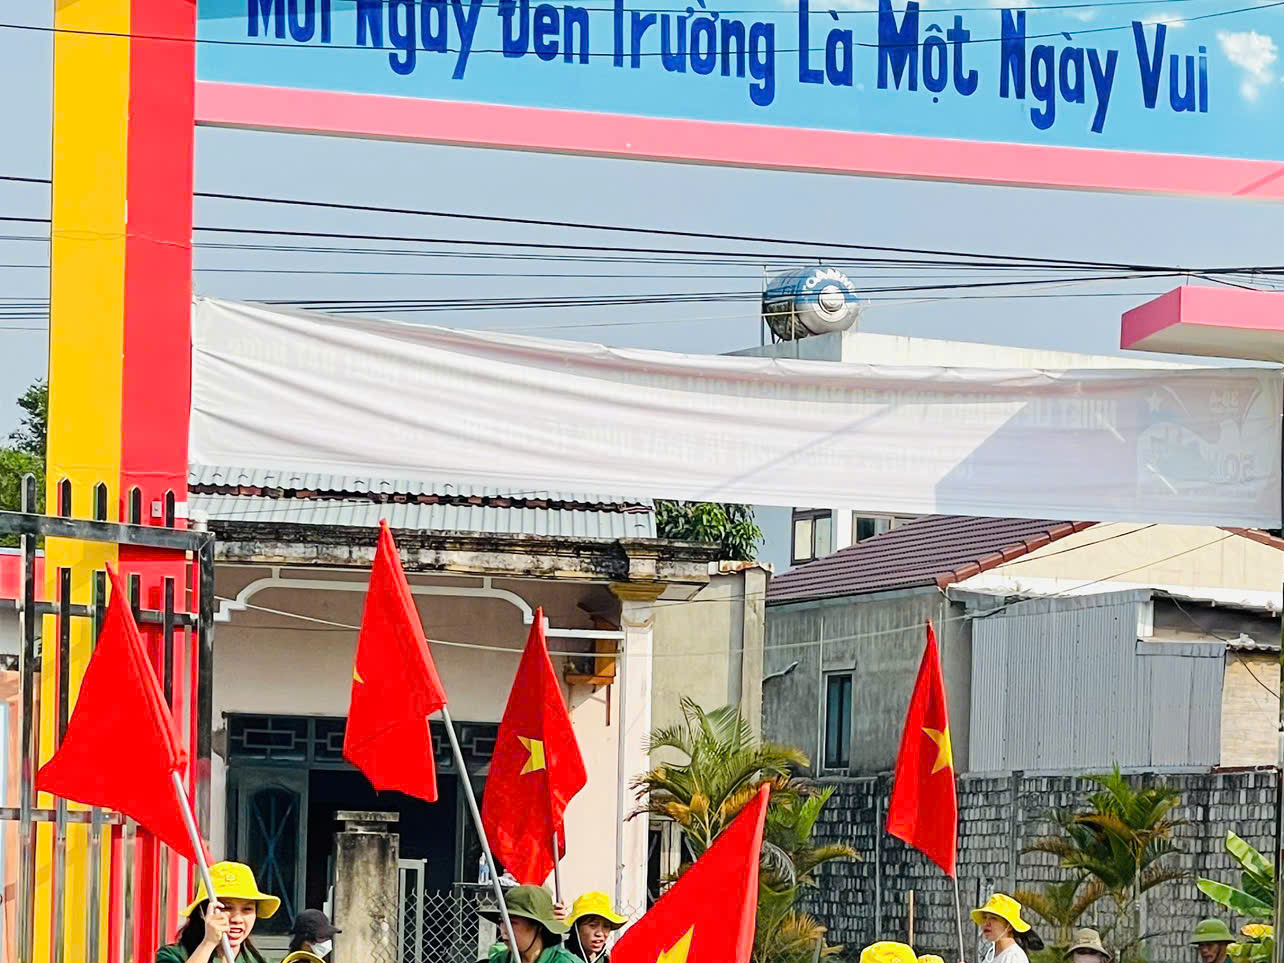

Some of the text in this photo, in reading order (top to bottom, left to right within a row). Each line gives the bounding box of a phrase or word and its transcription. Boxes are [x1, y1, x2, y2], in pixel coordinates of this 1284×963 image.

[799, 0, 853, 88] Là
[876, 0, 979, 104] Một
[999, 9, 1118, 134] Ngày
[1131, 20, 1209, 114] Vui
